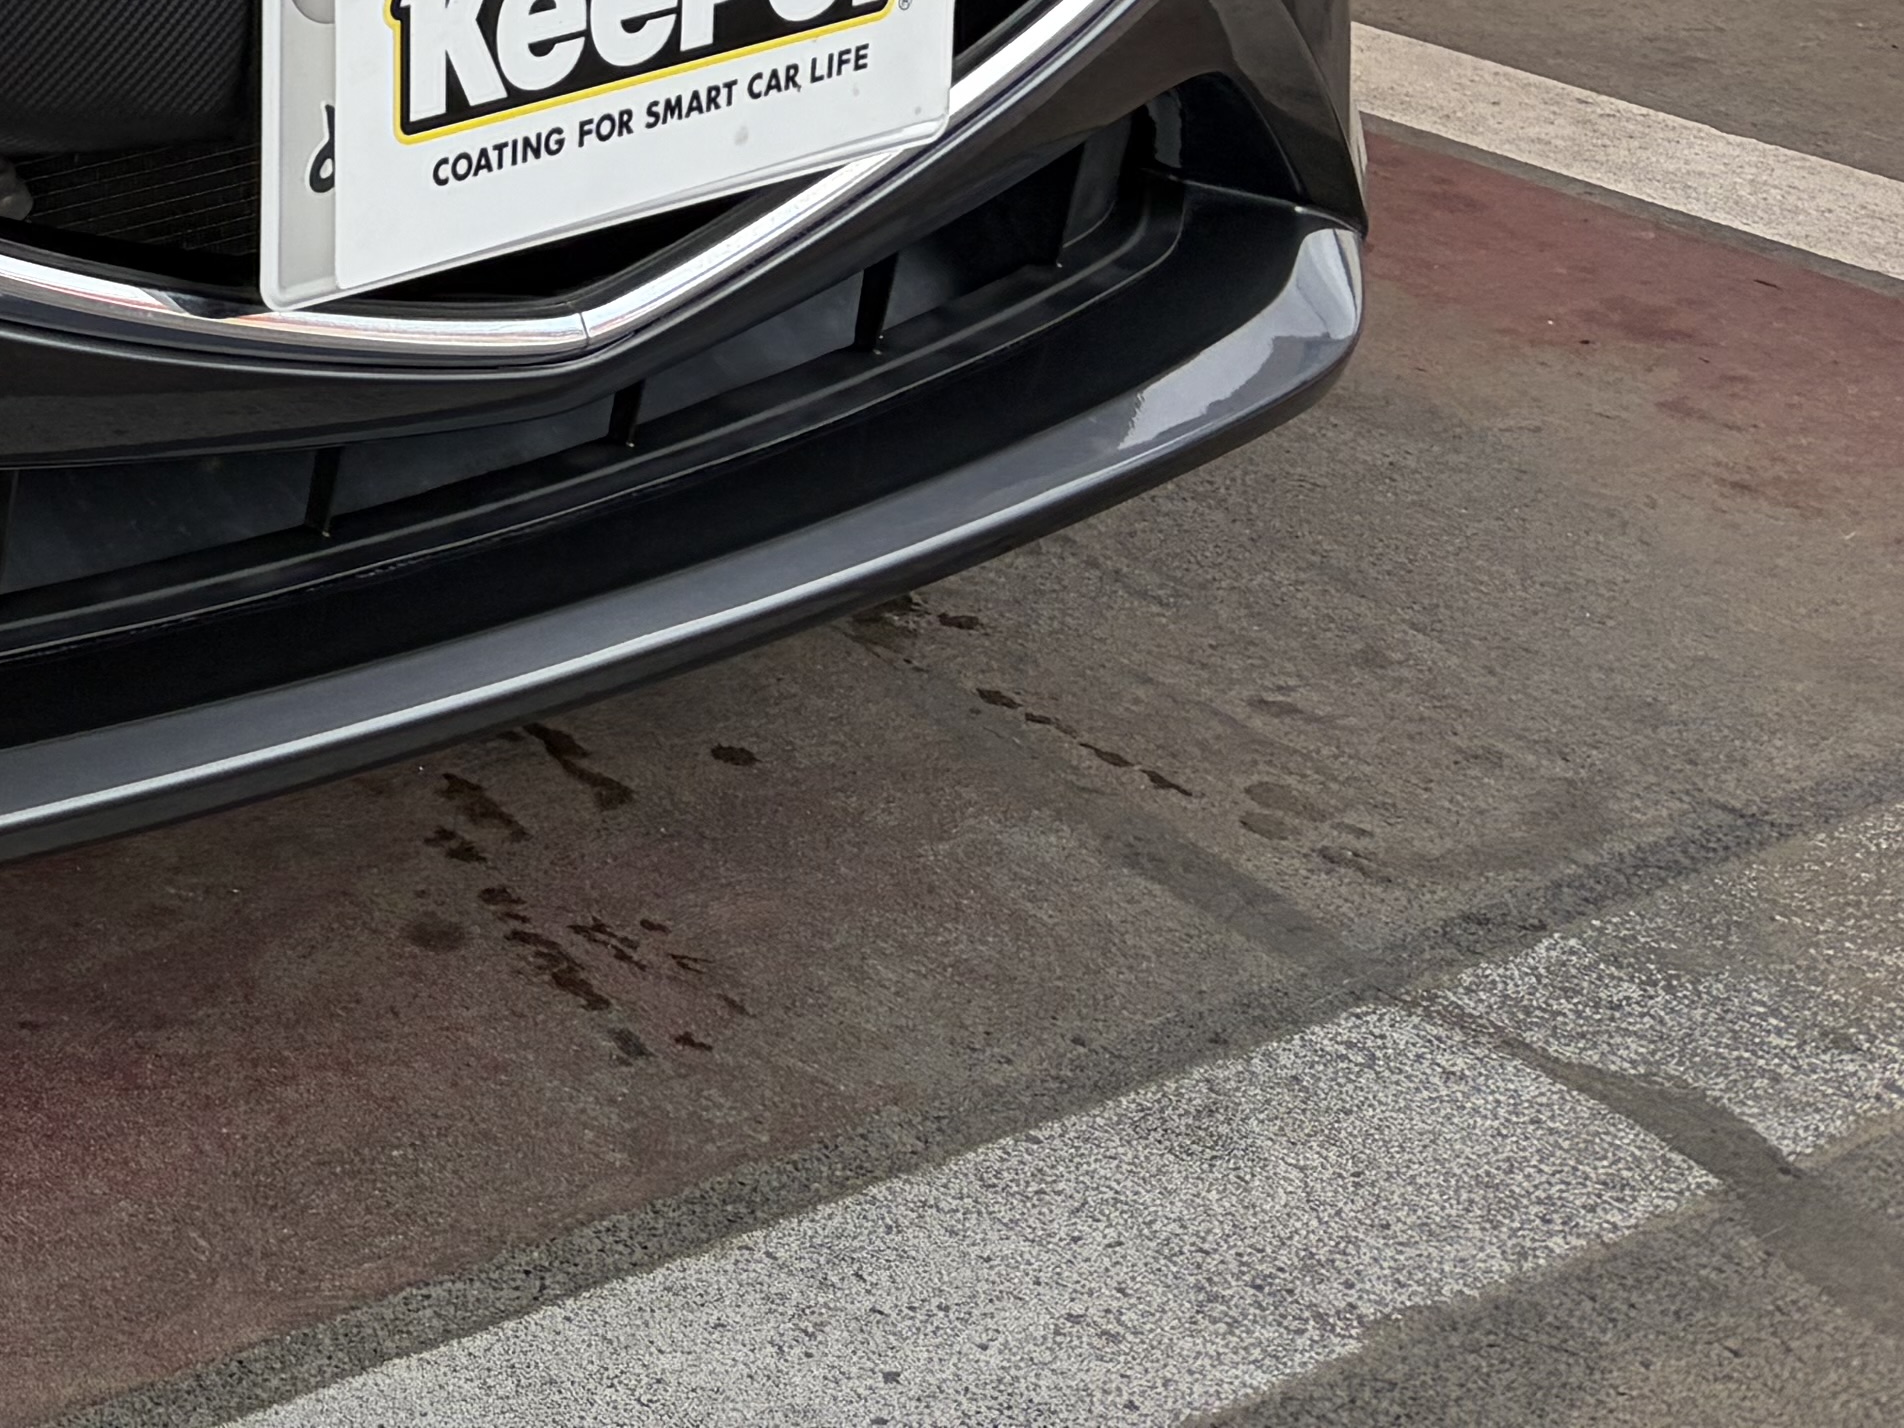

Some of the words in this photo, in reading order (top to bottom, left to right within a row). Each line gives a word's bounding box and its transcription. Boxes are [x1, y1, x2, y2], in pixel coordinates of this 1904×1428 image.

[432, 127, 565, 187] COATING
[578, 108, 634, 148] FOR
[645, 80, 738, 131] SMART
[747, 64, 800, 103] CAR
[810, 44, 869, 85] LIFE
